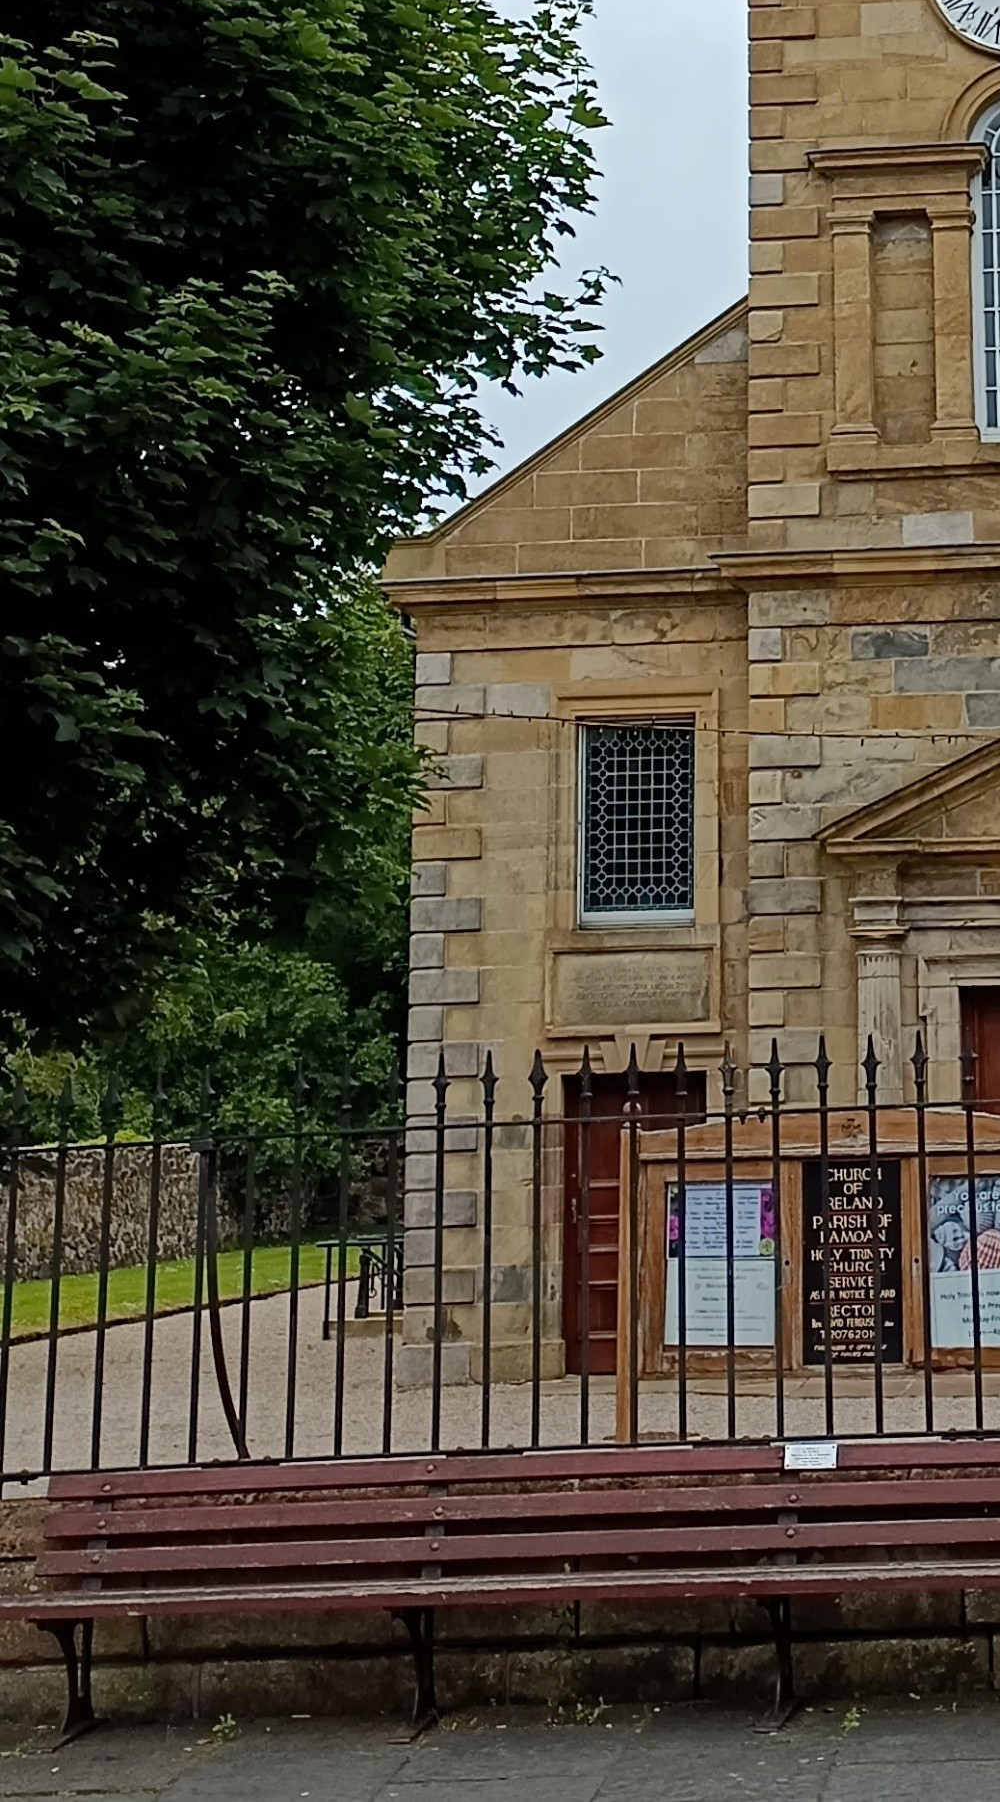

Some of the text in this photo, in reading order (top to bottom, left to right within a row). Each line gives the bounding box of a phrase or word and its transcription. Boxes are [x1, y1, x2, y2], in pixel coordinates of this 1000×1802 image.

[843, 1182, 863, 1195] OF
[953, 1190, 970, 1201] Yo
[979, 1191, 999, 1200] are
[828, 1196, 884, 1210] RELAND
[812, 1214, 867, 1229] PRISH
[849, 1247, 894, 1261] TRINTY
[869, 1288, 896, 1300] BARD
